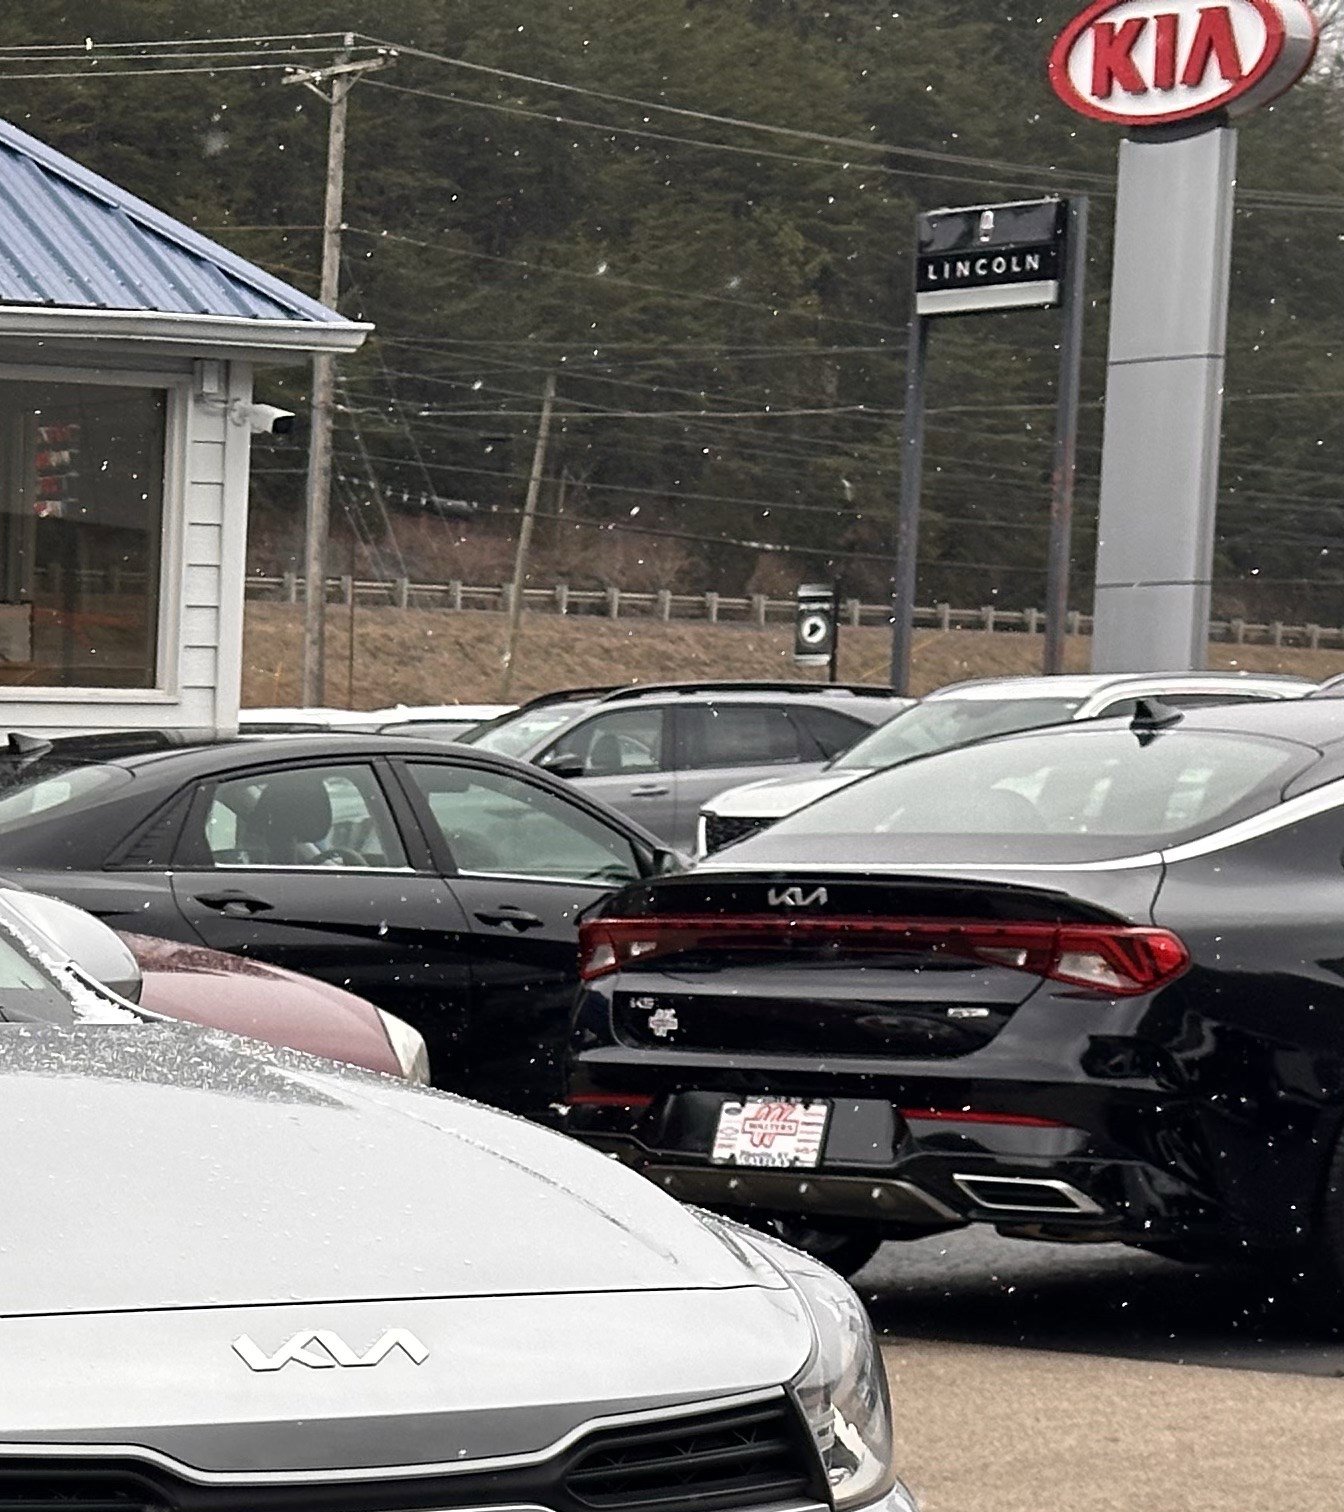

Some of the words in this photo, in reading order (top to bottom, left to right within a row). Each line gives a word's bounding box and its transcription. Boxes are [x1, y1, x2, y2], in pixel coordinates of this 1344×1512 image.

[1090, 5, 1243, 99] KIA
[926, 253, 1042, 281] LINCOLN
[767, 886, 828, 906] KIA
[231, 1327, 431, 1372] KIA
